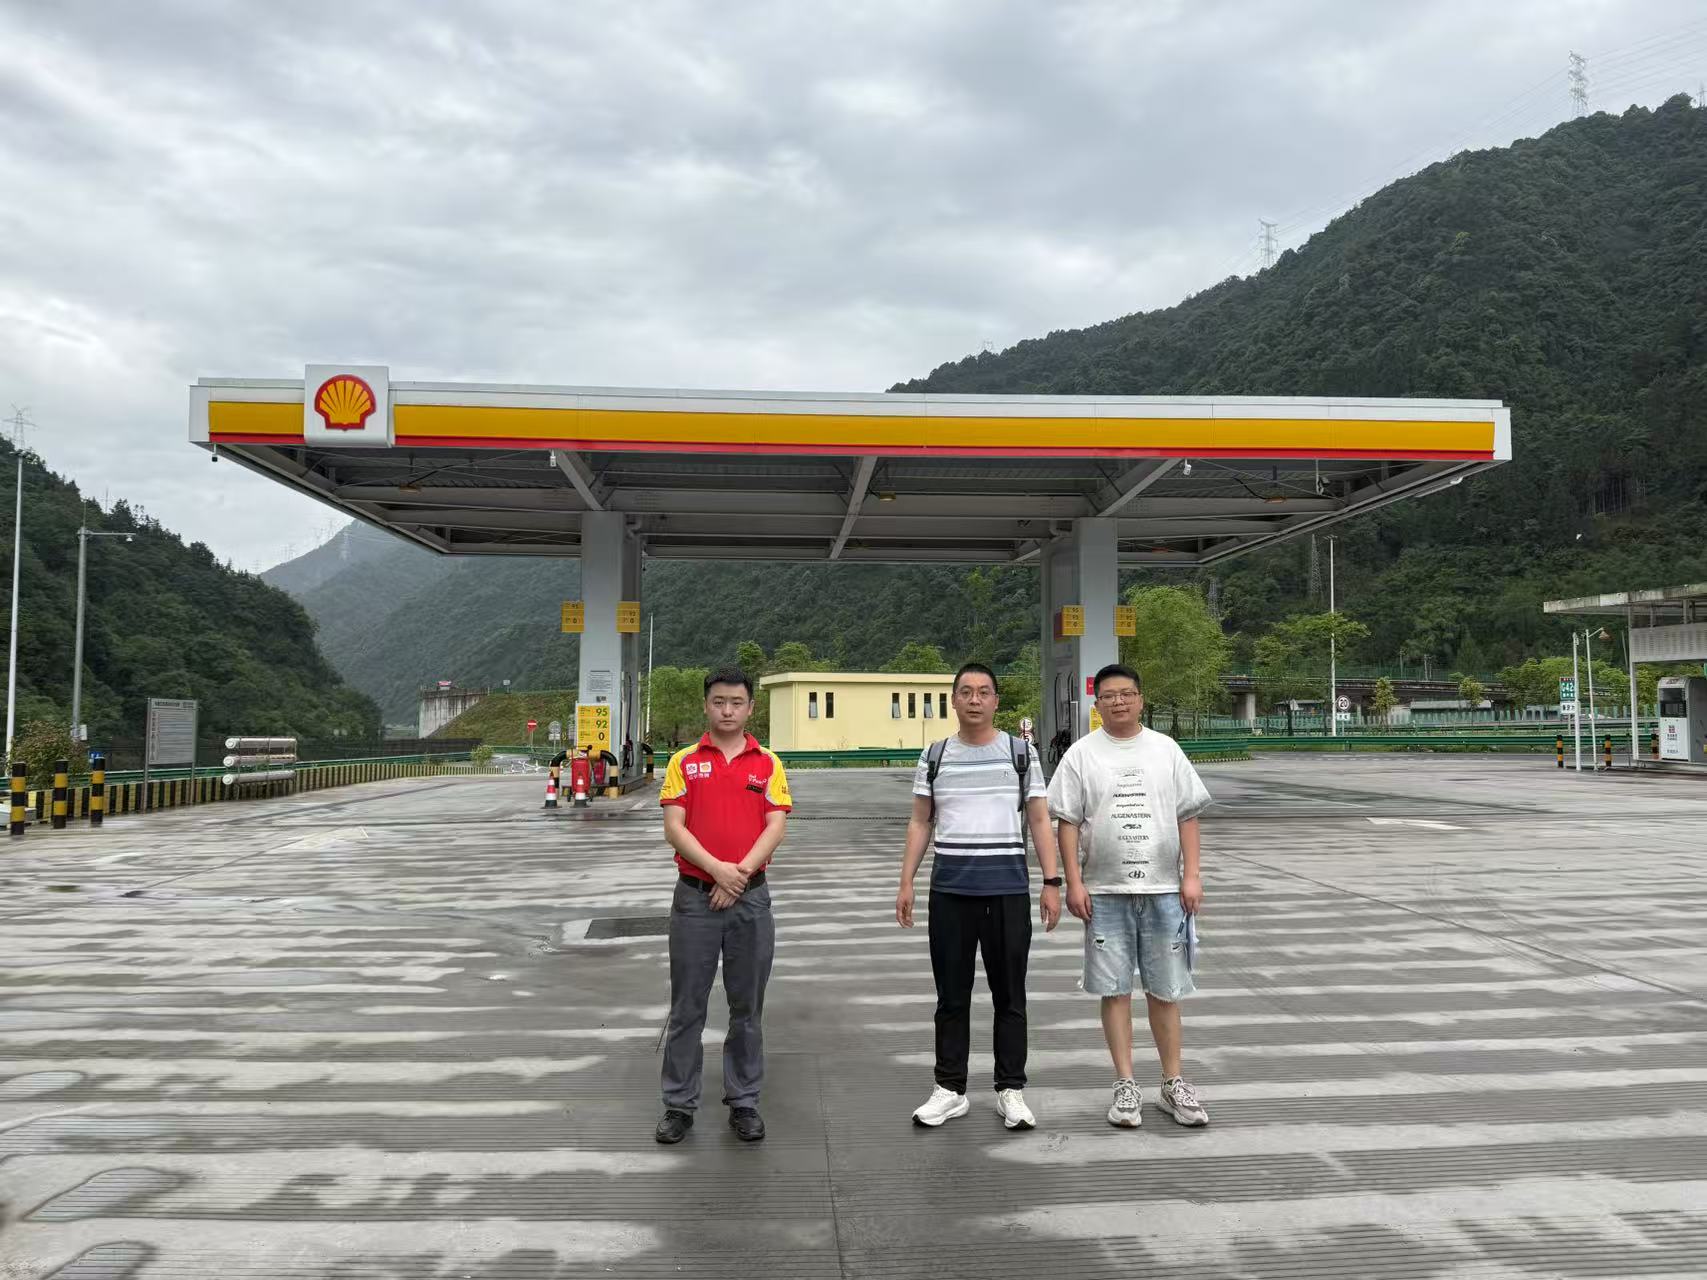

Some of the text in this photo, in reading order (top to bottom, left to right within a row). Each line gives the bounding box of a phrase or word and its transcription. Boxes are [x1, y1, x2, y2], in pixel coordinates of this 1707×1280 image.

[596, 707, 608, 716] 95
[596, 720, 607, 729] 92
[598, 731, 605, 741] 0
